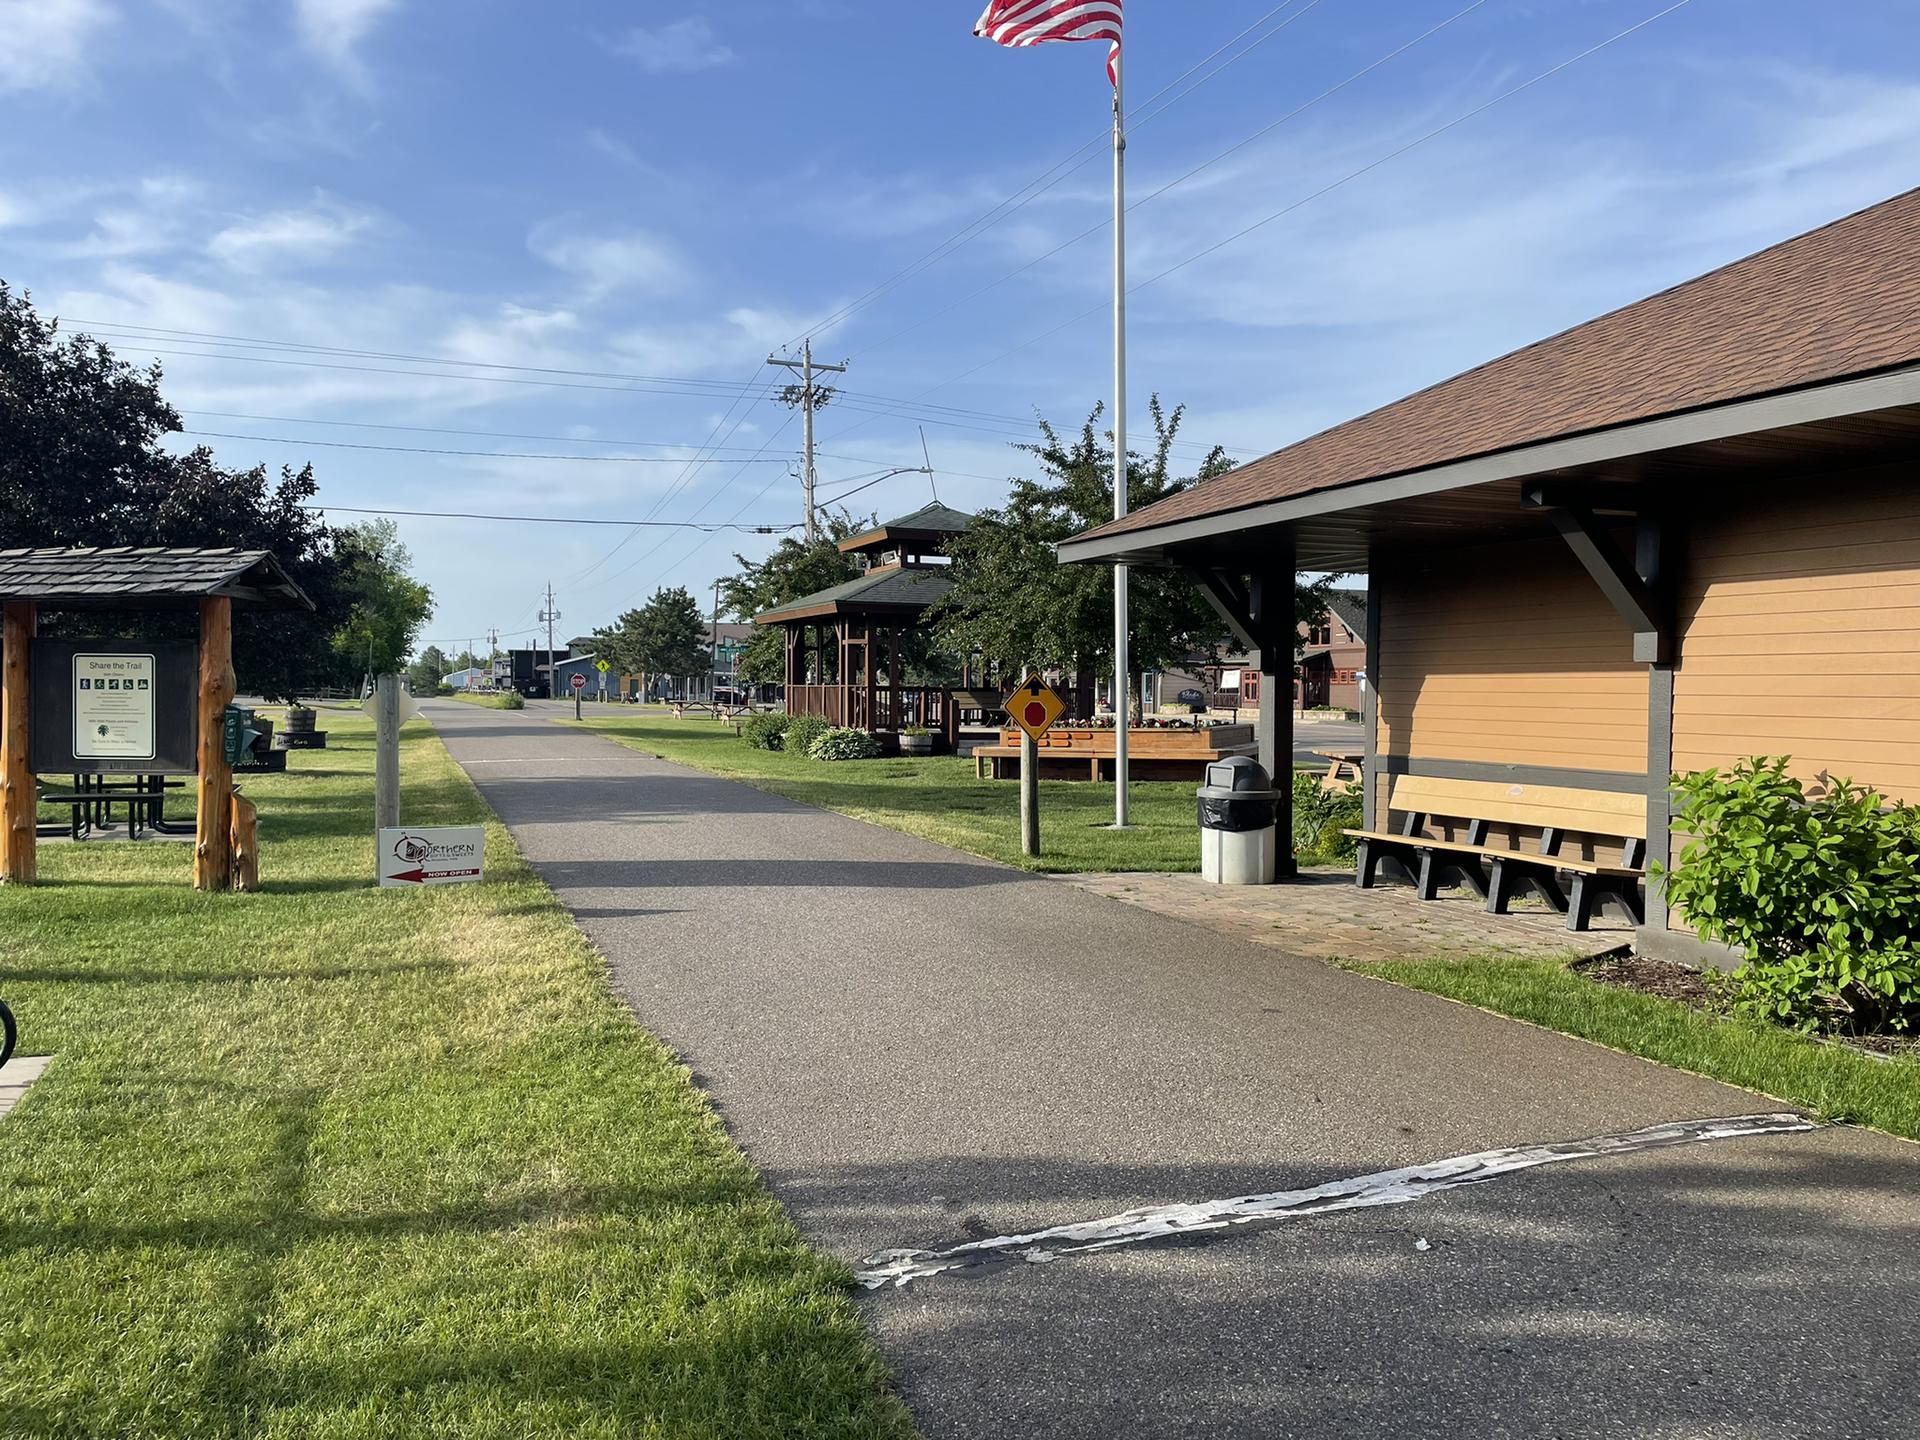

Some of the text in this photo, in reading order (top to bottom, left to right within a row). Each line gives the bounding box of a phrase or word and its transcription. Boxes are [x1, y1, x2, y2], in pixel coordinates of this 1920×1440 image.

[89, 661, 142, 670] Share the Trail
